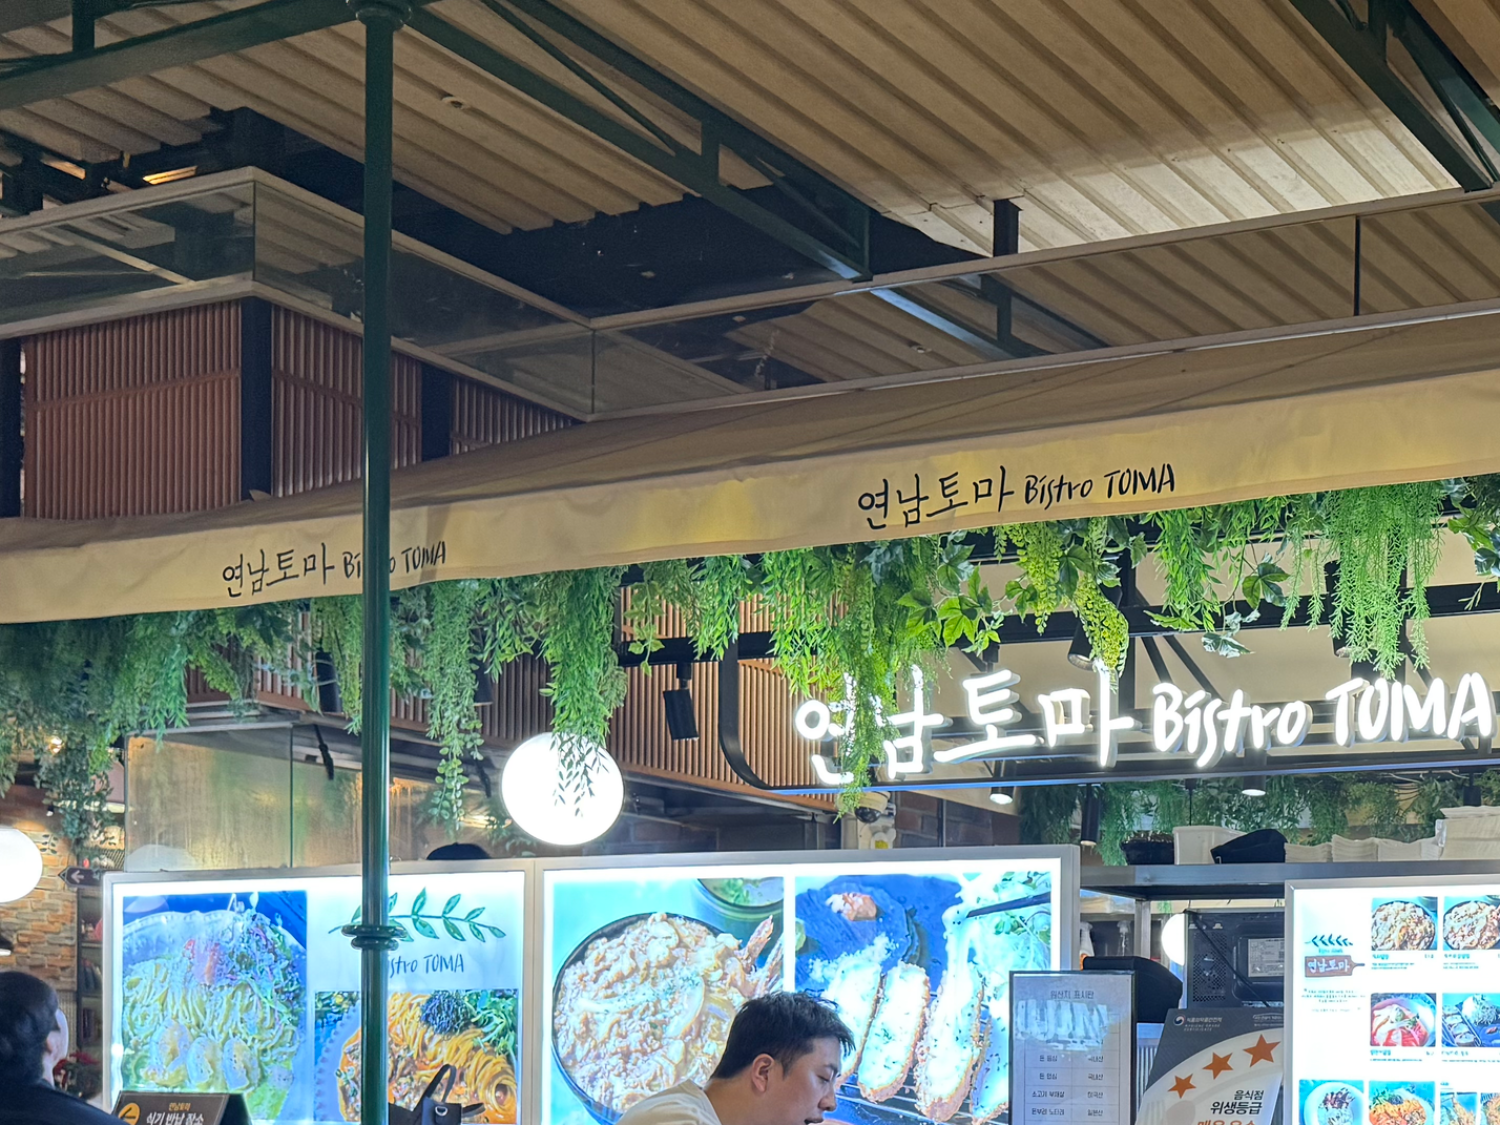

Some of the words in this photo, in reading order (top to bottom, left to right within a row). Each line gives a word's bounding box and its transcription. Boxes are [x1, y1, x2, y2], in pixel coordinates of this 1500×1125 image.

[857, 465, 1015, 530] 연남토마
[1024, 474, 1093, 510] Bistro
[1103, 463, 1175, 499] TOMA
[222, 542, 335, 598] 연남토마
[342, 551, 396, 579] Bio
[401, 541, 447, 573] TOMA
[794, 659, 1136, 786] 연남토마
[1152, 682, 1311, 769] Bistro
[1325, 672, 1496, 747] TOMA
[390, 953, 418, 979] stro
[423, 953, 464, 974] TOMA
[1307, 958, 1351, 974] 연남토마
[1210, 1101, 1263, 1115] 위생등급
[1234, 1090, 1264, 1100] 음식점
